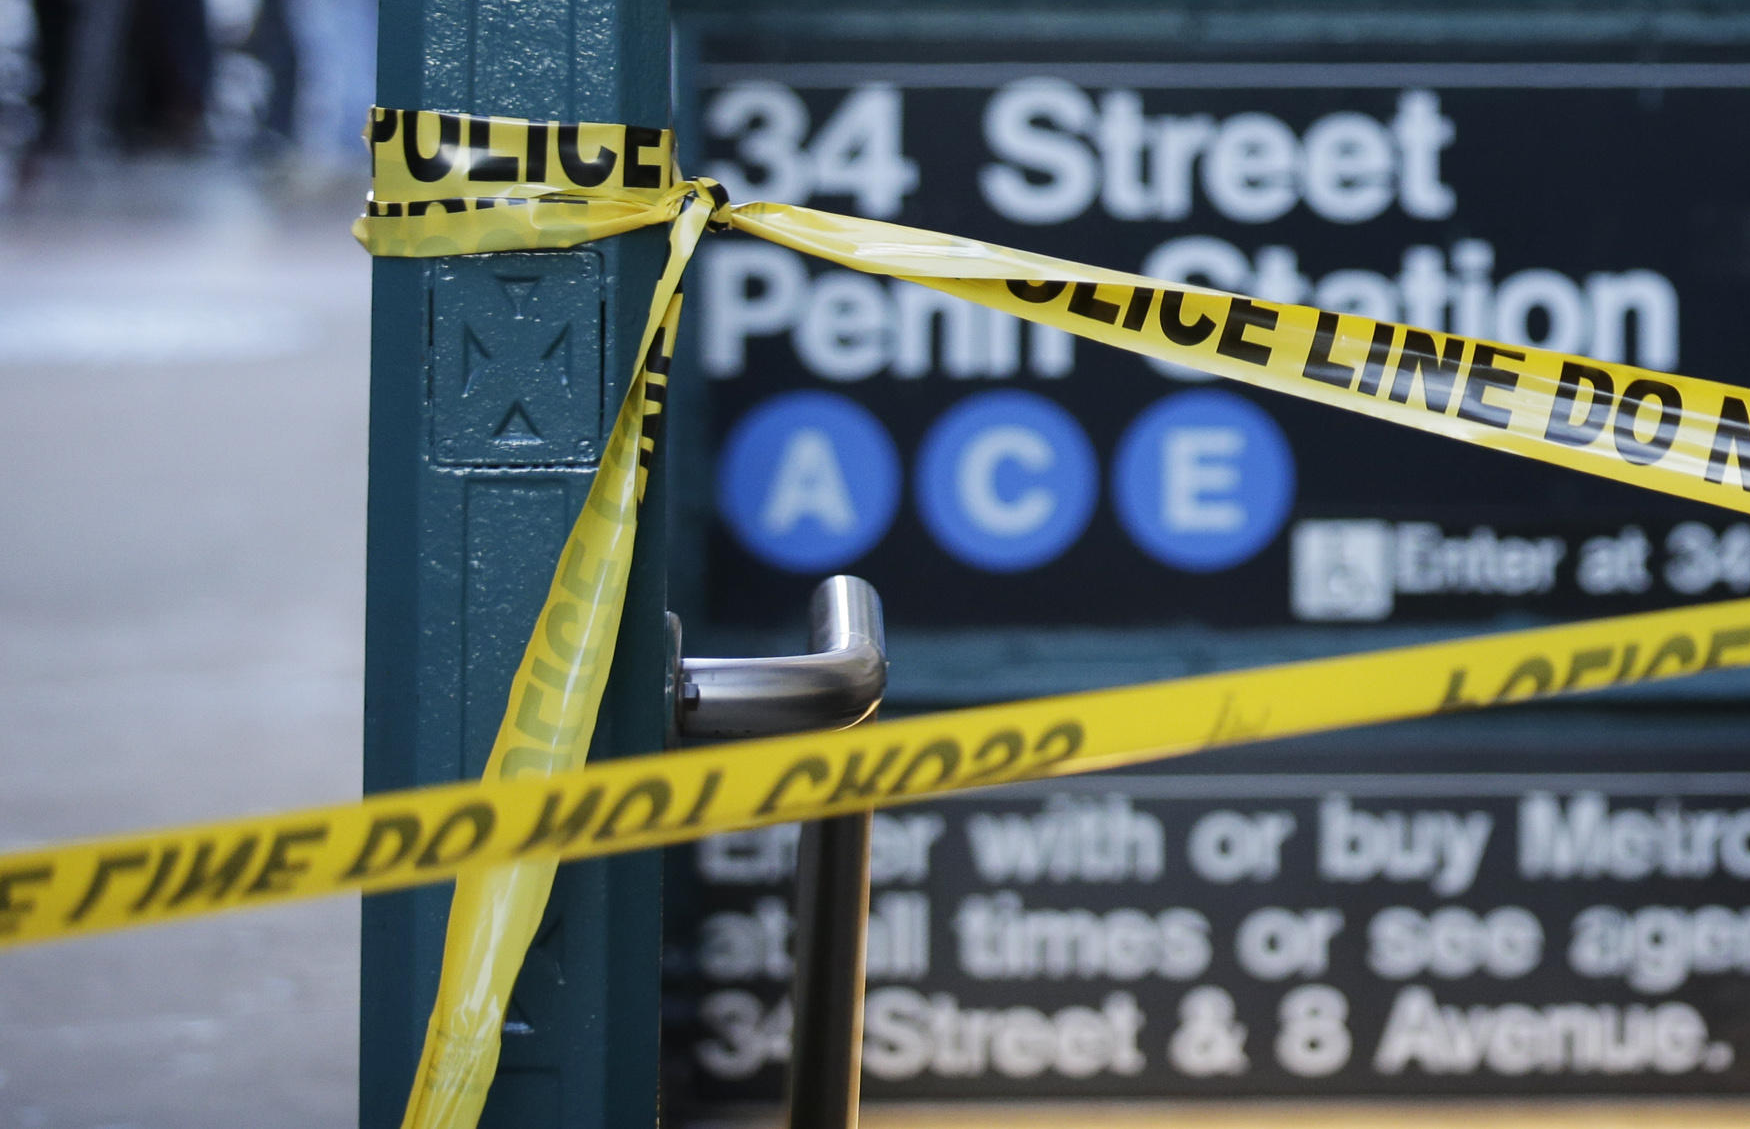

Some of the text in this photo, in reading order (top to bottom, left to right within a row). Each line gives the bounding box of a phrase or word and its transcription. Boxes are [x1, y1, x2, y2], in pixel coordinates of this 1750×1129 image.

[371, 107, 663, 187] POLICE
[704, 76, 1457, 225] 34 Street
[702, 238, 1078, 379] Penn
[1003, 279, 1280, 367] LICE
[1302, 310, 1526, 430] LINE
[1543, 361, 1683, 466] DO
[763, 424, 1248, 539] A C E
[1402, 521, 1565, 595] Enter
[1576, 526, 1654, 595] at
[962, 792, 1167, 884] with
[1186, 808, 1297, 884] or
[1316, 792, 1493, 896] buy
[700, 896, 793, 981] at
[953, 888, 1213, 983] times
[1235, 905, 1345, 982] or
[1366, 904, 1545, 978] see
[862, 984, 1147, 1079] Street
[1167, 983, 1250, 1078] &
[1274, 983, 1353, 1079] 8
[1373, 984, 1736, 1076] Avenue.
